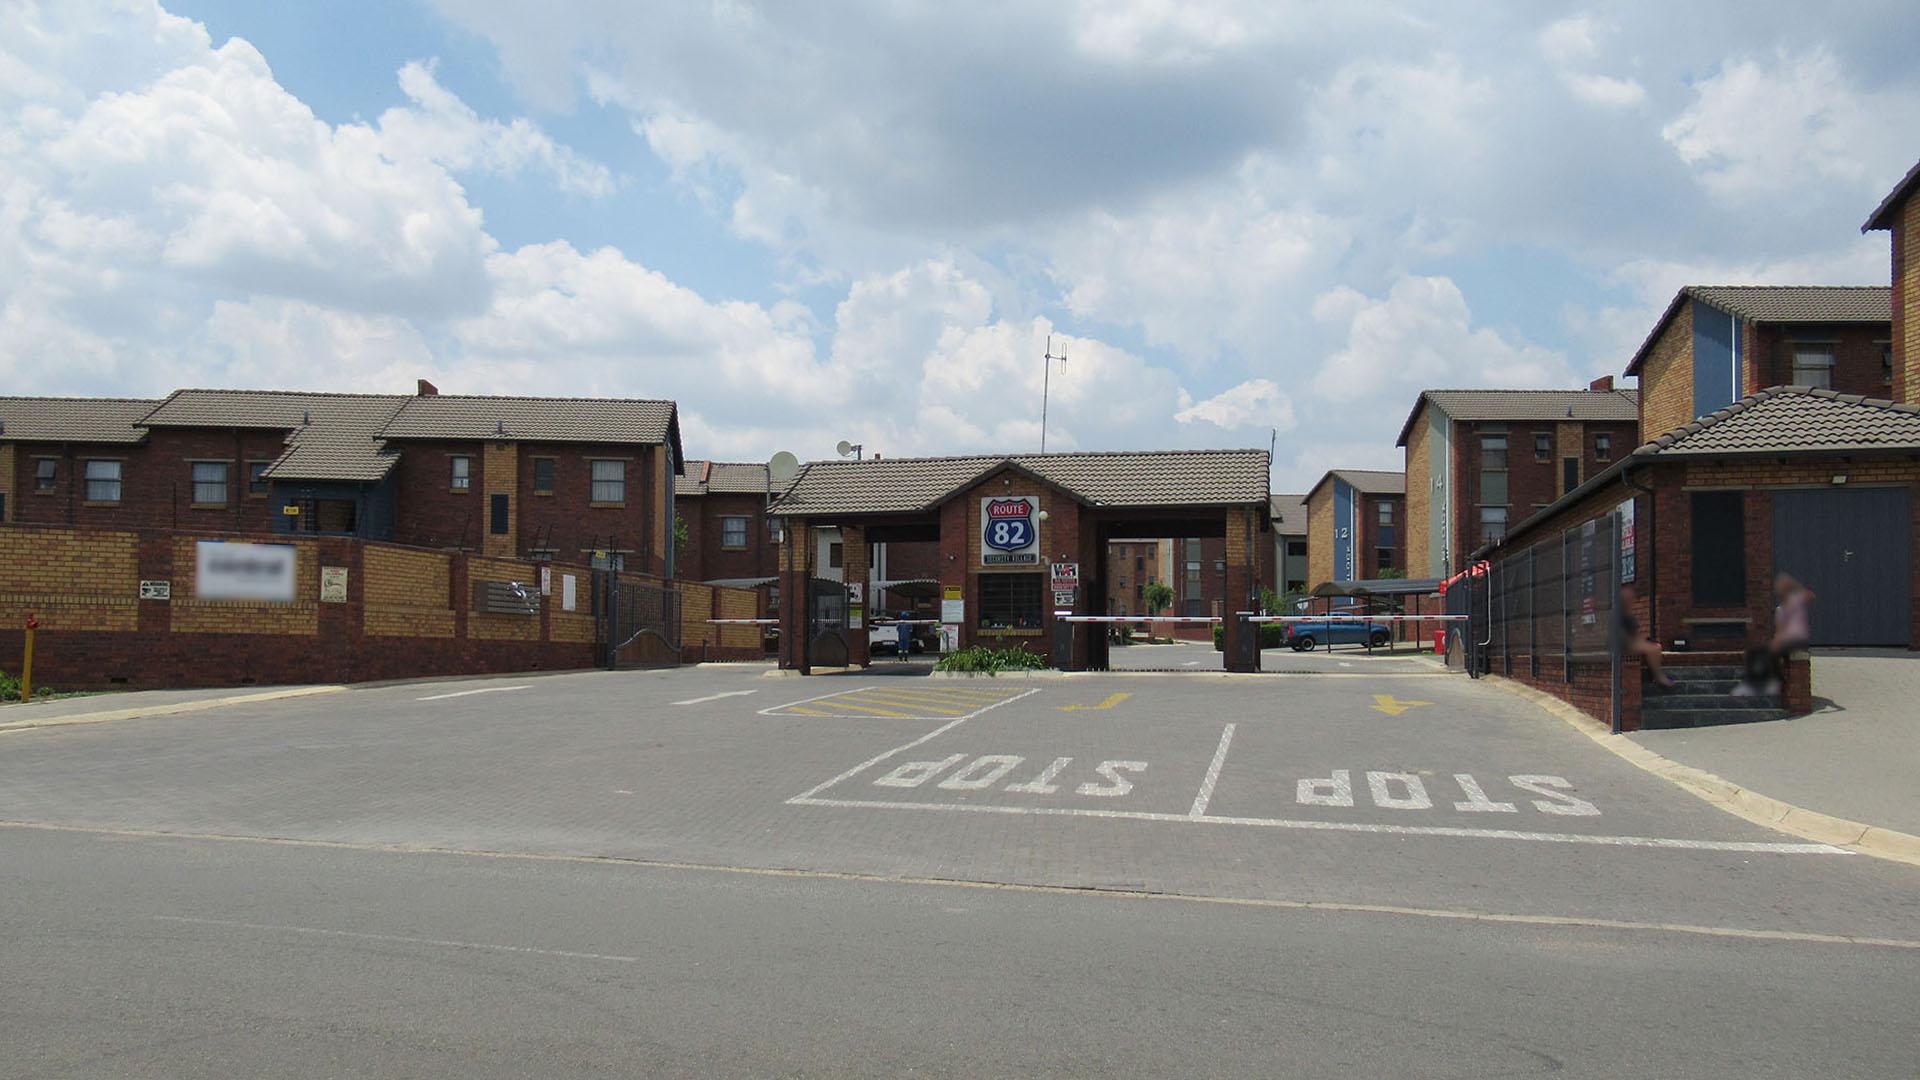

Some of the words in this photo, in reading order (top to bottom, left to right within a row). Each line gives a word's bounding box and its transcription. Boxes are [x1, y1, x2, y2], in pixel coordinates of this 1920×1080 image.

[993, 505, 1024, 515] ROUTE
[994, 521, 1025, 545] 82
[1335, 527, 1348, 539] 12
[872, 753, 1148, 797] STOP
[1296, 769, 1601, 816] STOP
